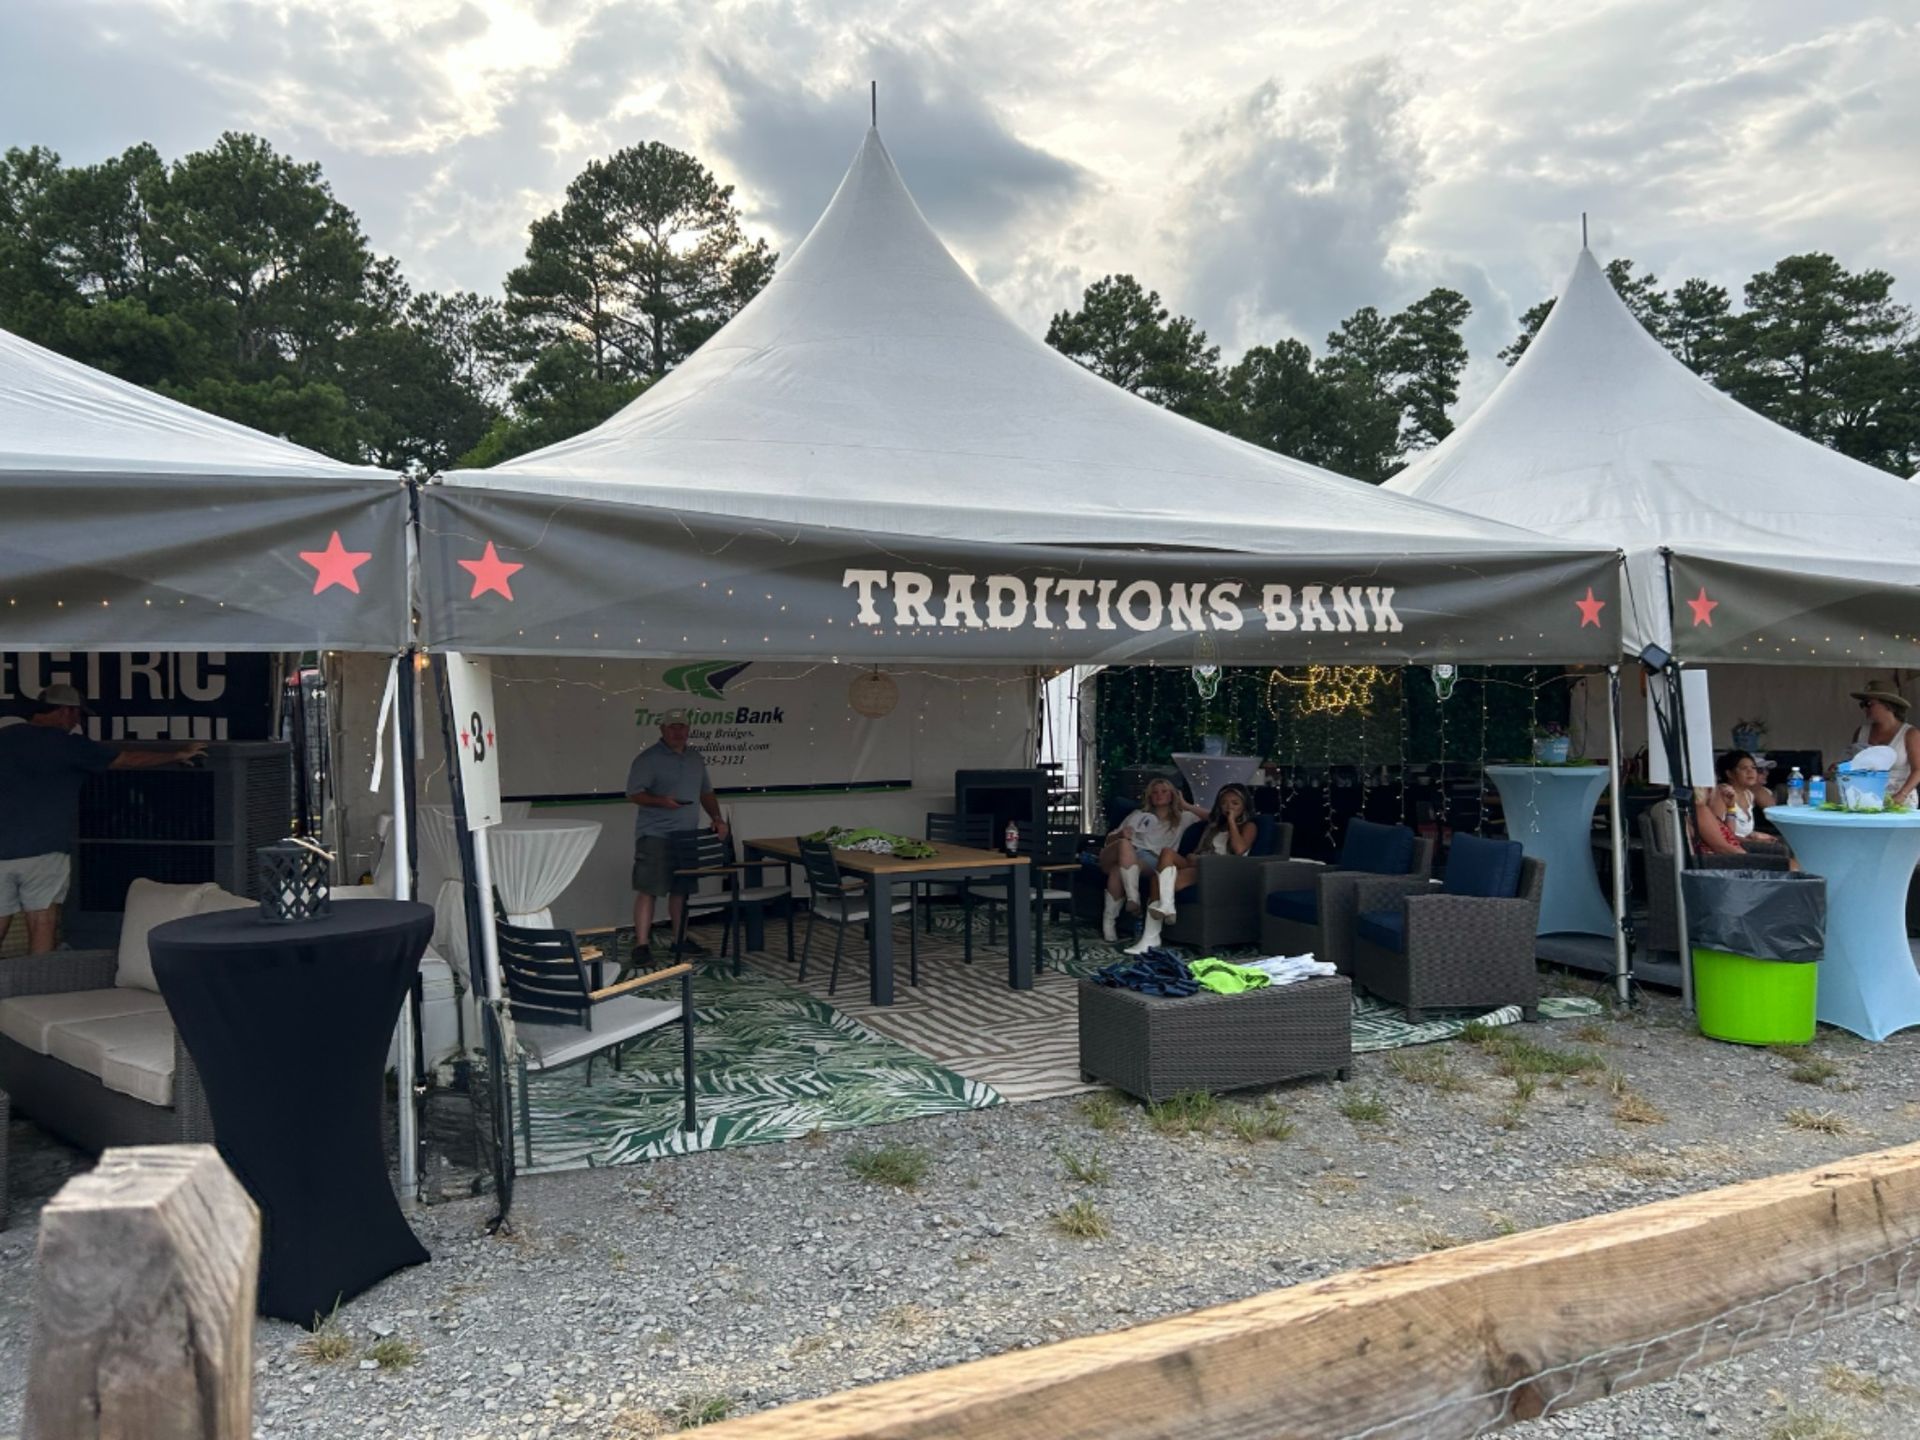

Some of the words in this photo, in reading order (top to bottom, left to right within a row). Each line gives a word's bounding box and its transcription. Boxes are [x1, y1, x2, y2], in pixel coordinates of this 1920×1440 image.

[843, 568, 1247, 632] TRADITIONS
[1262, 584, 1403, 633] BANK
[470, 711, 485, 763] 3
[634, 706, 784, 726] TrationsBank
